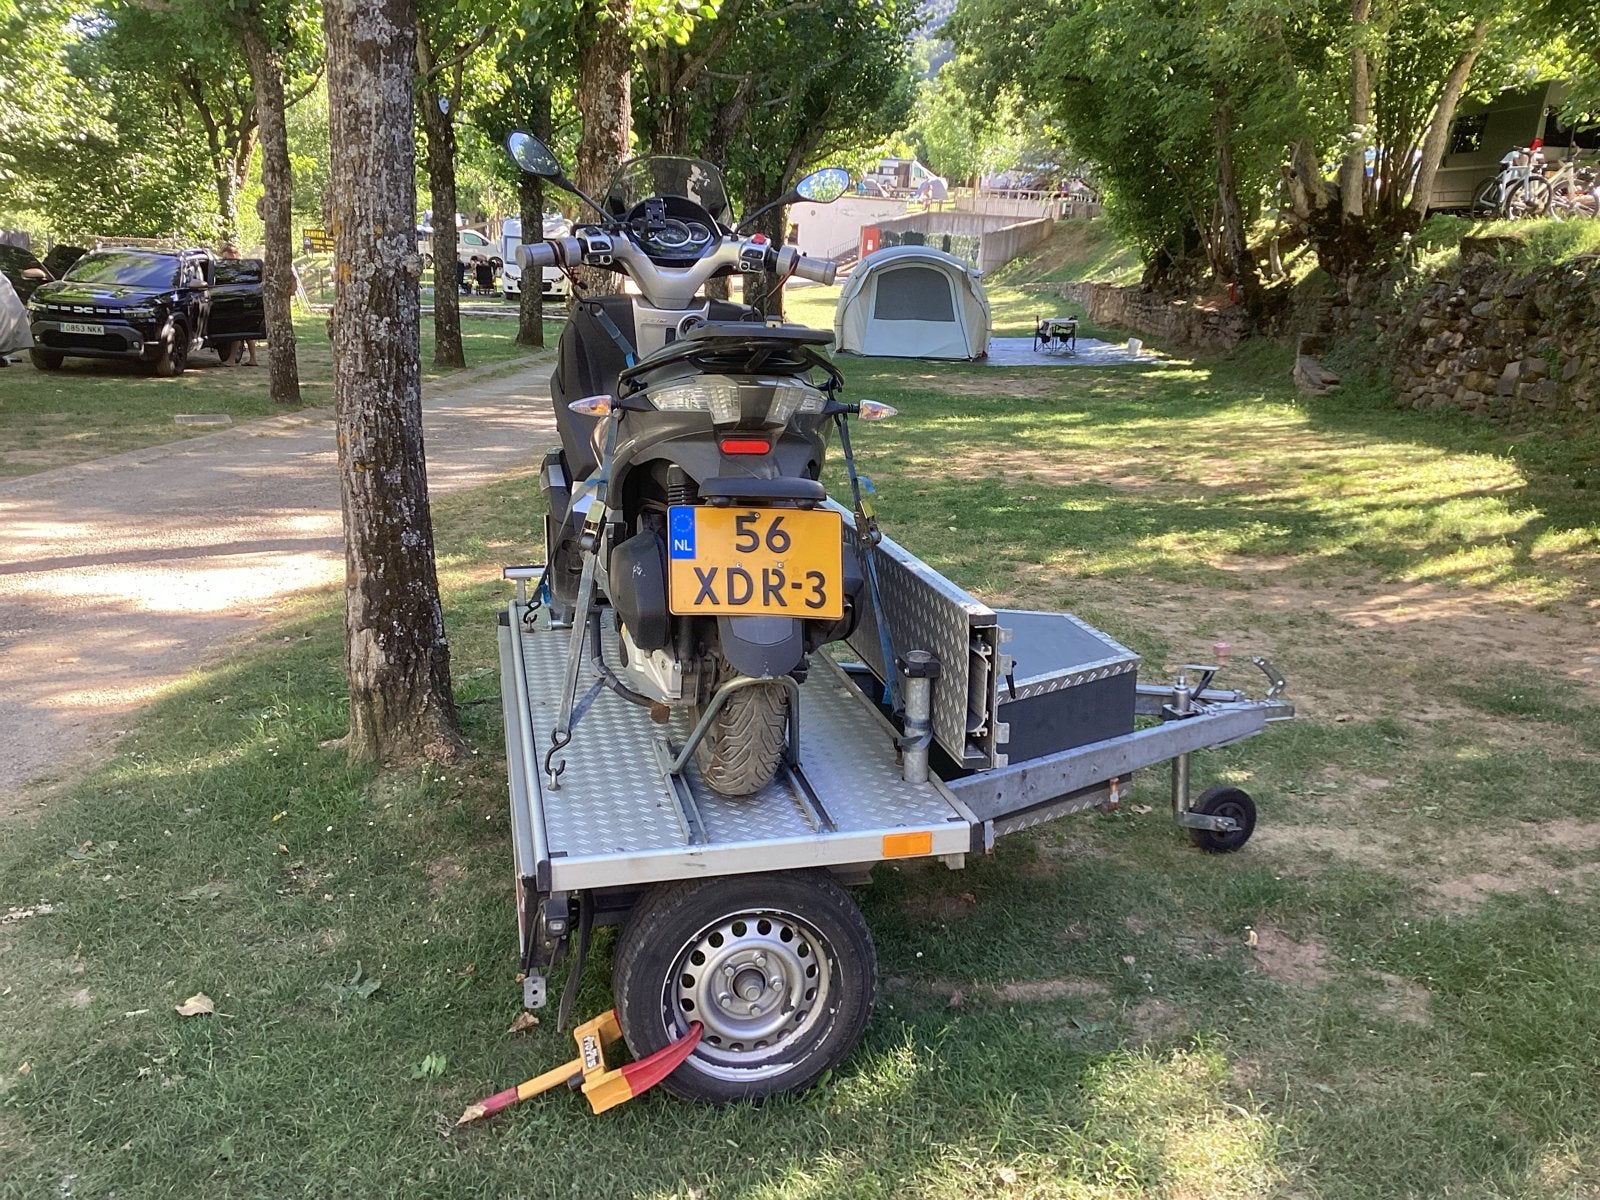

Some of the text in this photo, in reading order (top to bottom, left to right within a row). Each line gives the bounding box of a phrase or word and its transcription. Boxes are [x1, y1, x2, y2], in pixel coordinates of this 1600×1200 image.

[87, 326, 103, 334] NKK
[674, 539, 692, 551] NL
[735, 513, 791, 553] 56
[693, 566, 827, 609] XDR-3
